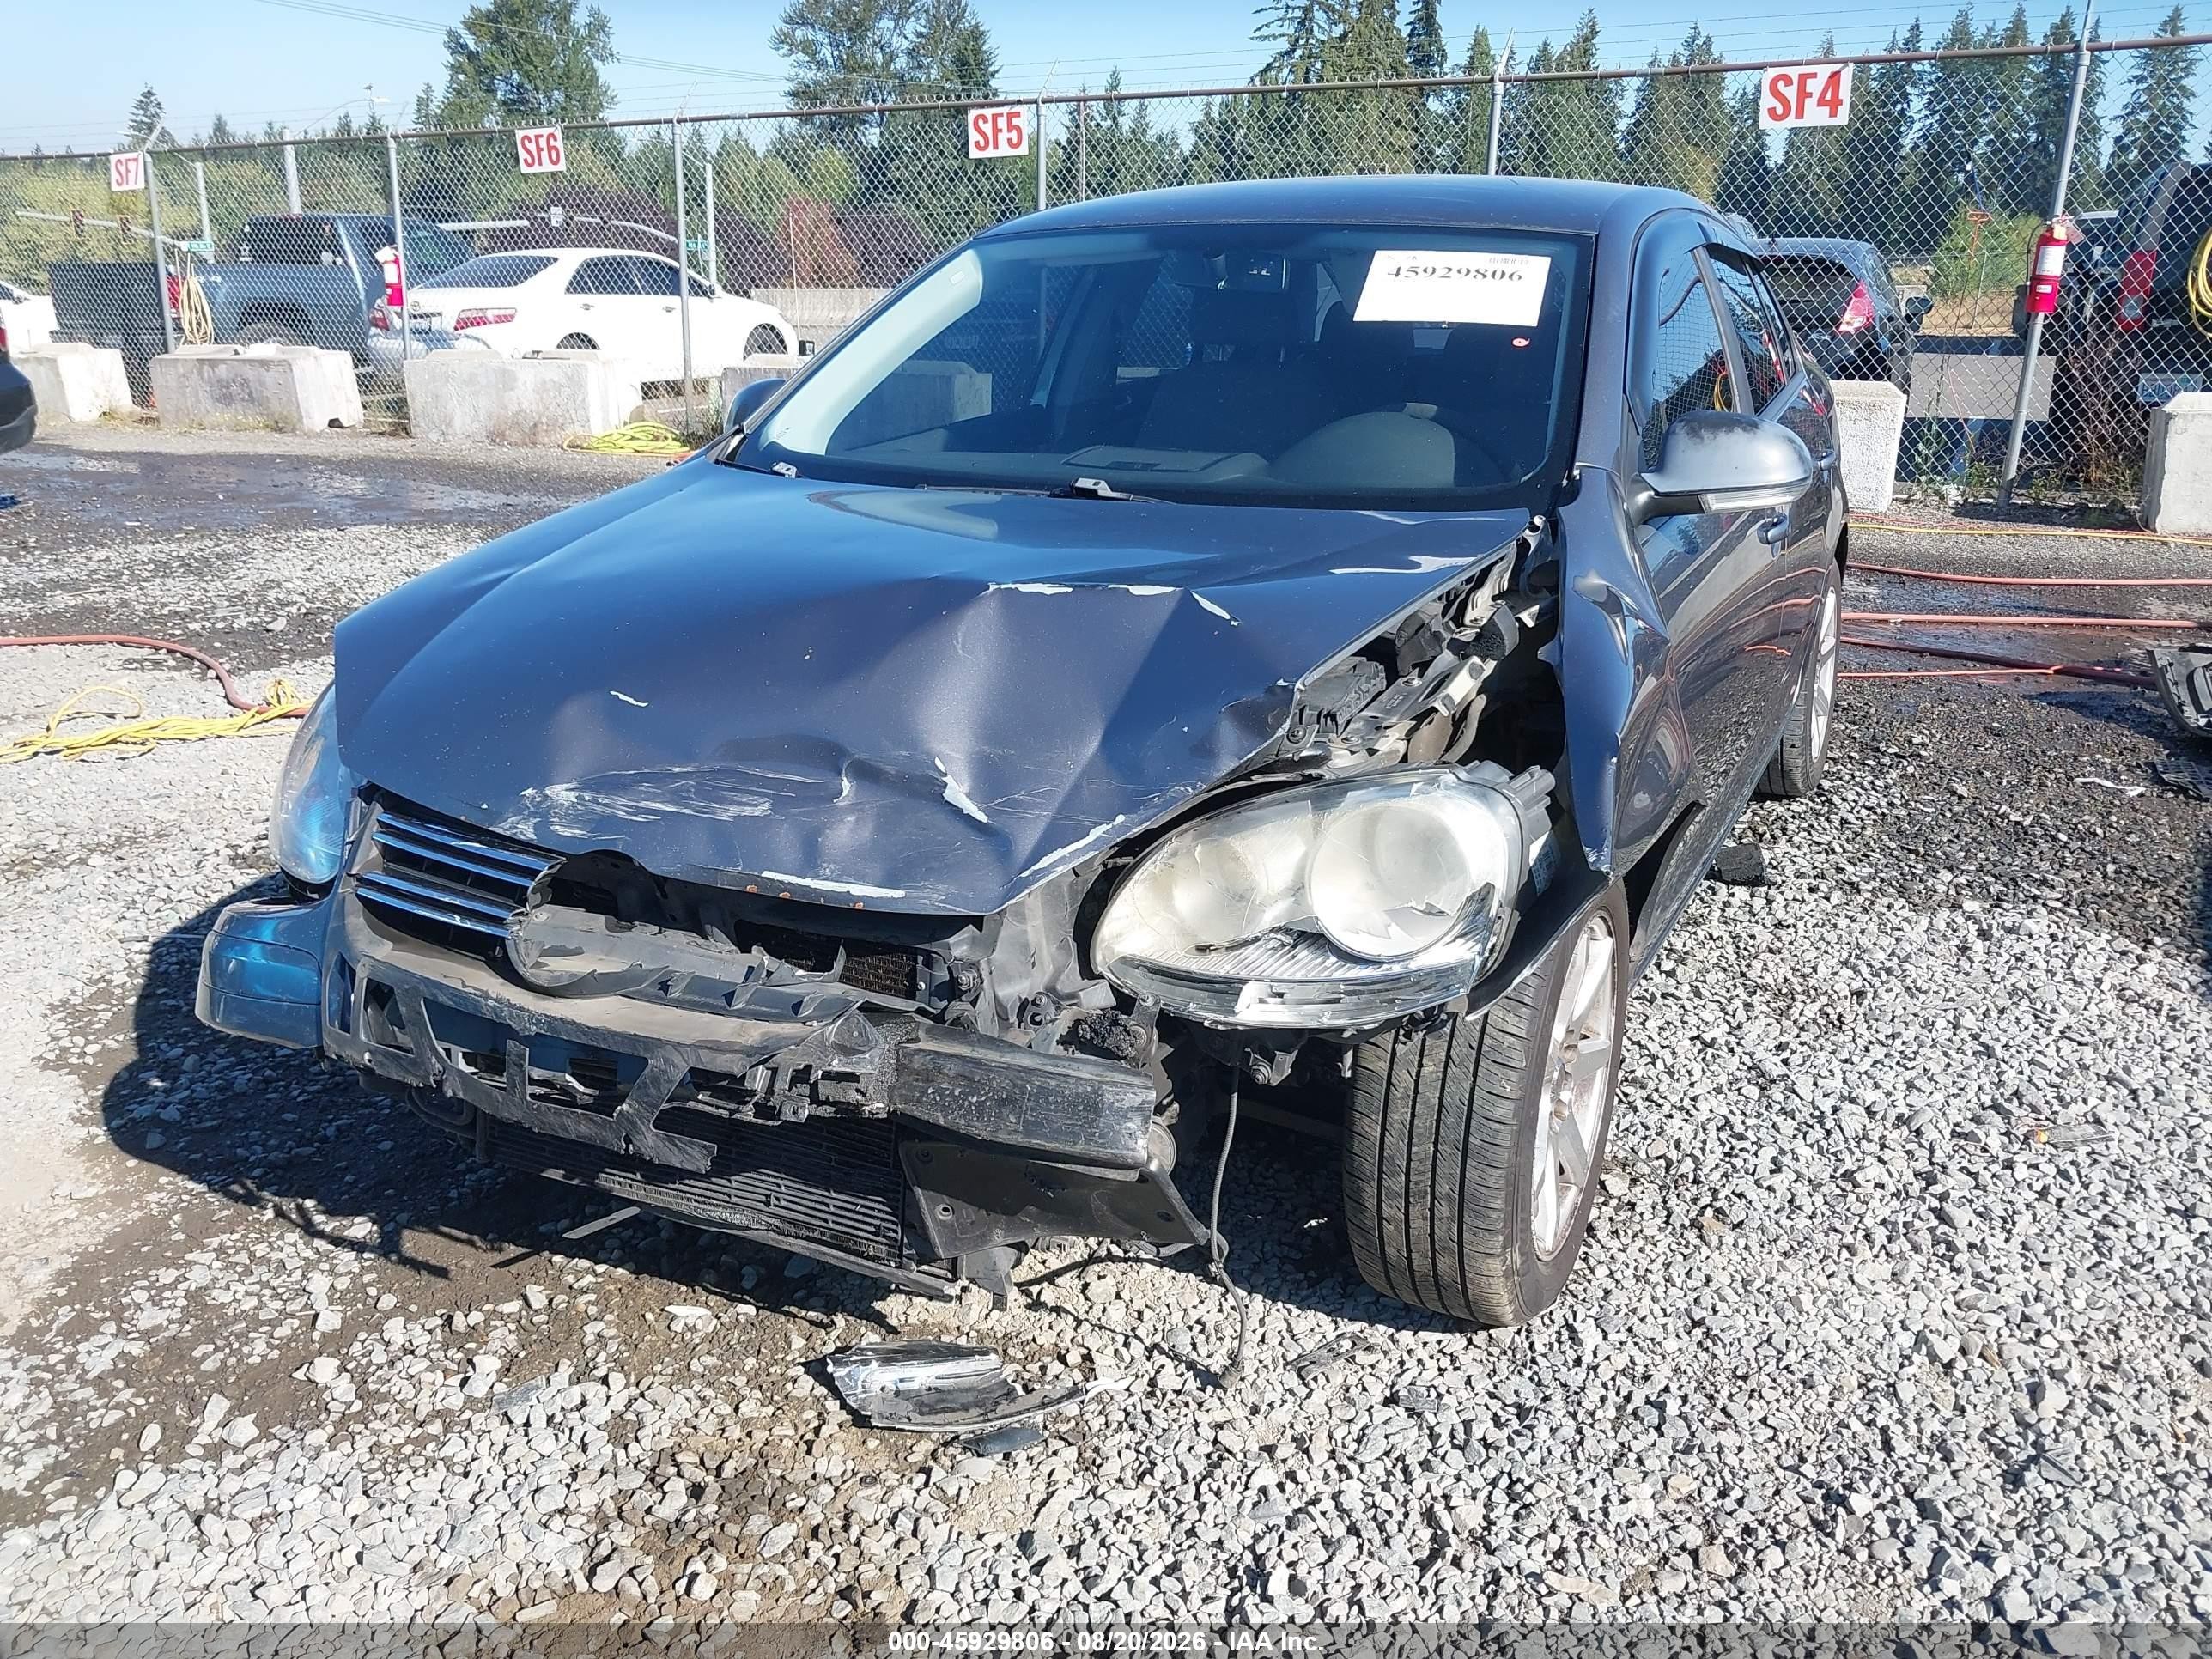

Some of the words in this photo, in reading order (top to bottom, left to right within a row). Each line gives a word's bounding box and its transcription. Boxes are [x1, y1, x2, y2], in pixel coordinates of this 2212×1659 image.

[1768, 70, 1843, 121] SF4
[972, 111, 1023, 152] SF5
[520, 132, 561, 167] SF6
[114, 158, 139, 186] SF7
[1387, 265, 1523, 283] 45929806
